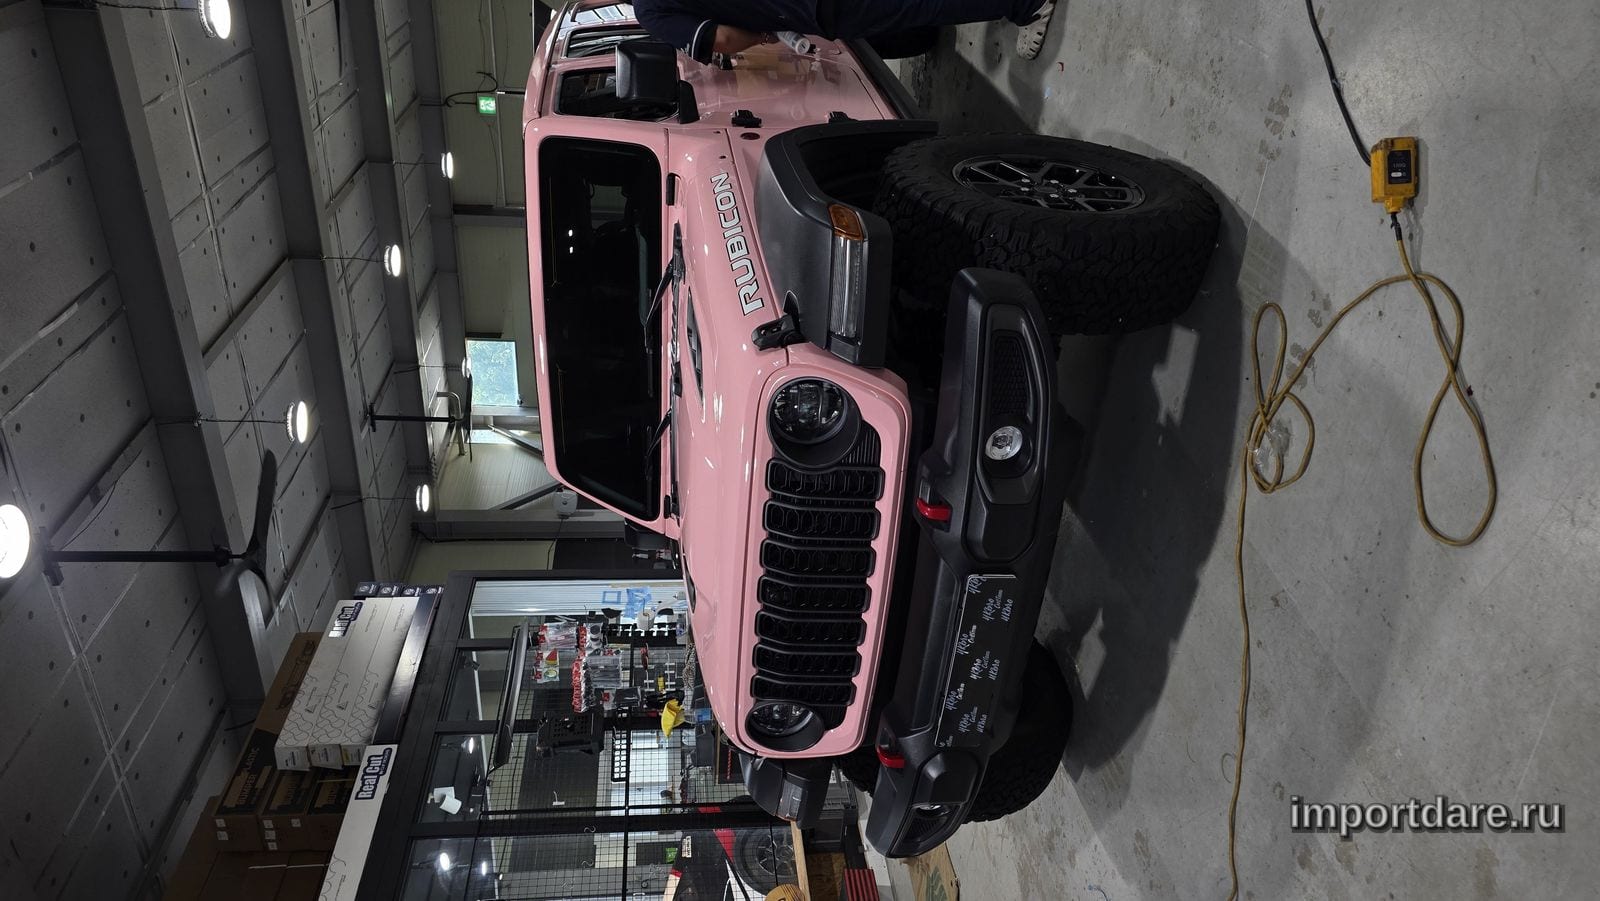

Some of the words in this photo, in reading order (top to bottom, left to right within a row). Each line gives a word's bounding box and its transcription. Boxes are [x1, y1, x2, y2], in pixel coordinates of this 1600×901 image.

[710, 172, 765, 316] RUBICON
[339, 606, 355, 620] Cut
[366, 756, 383, 773] Cut
[358, 776, 377, 798] Real
